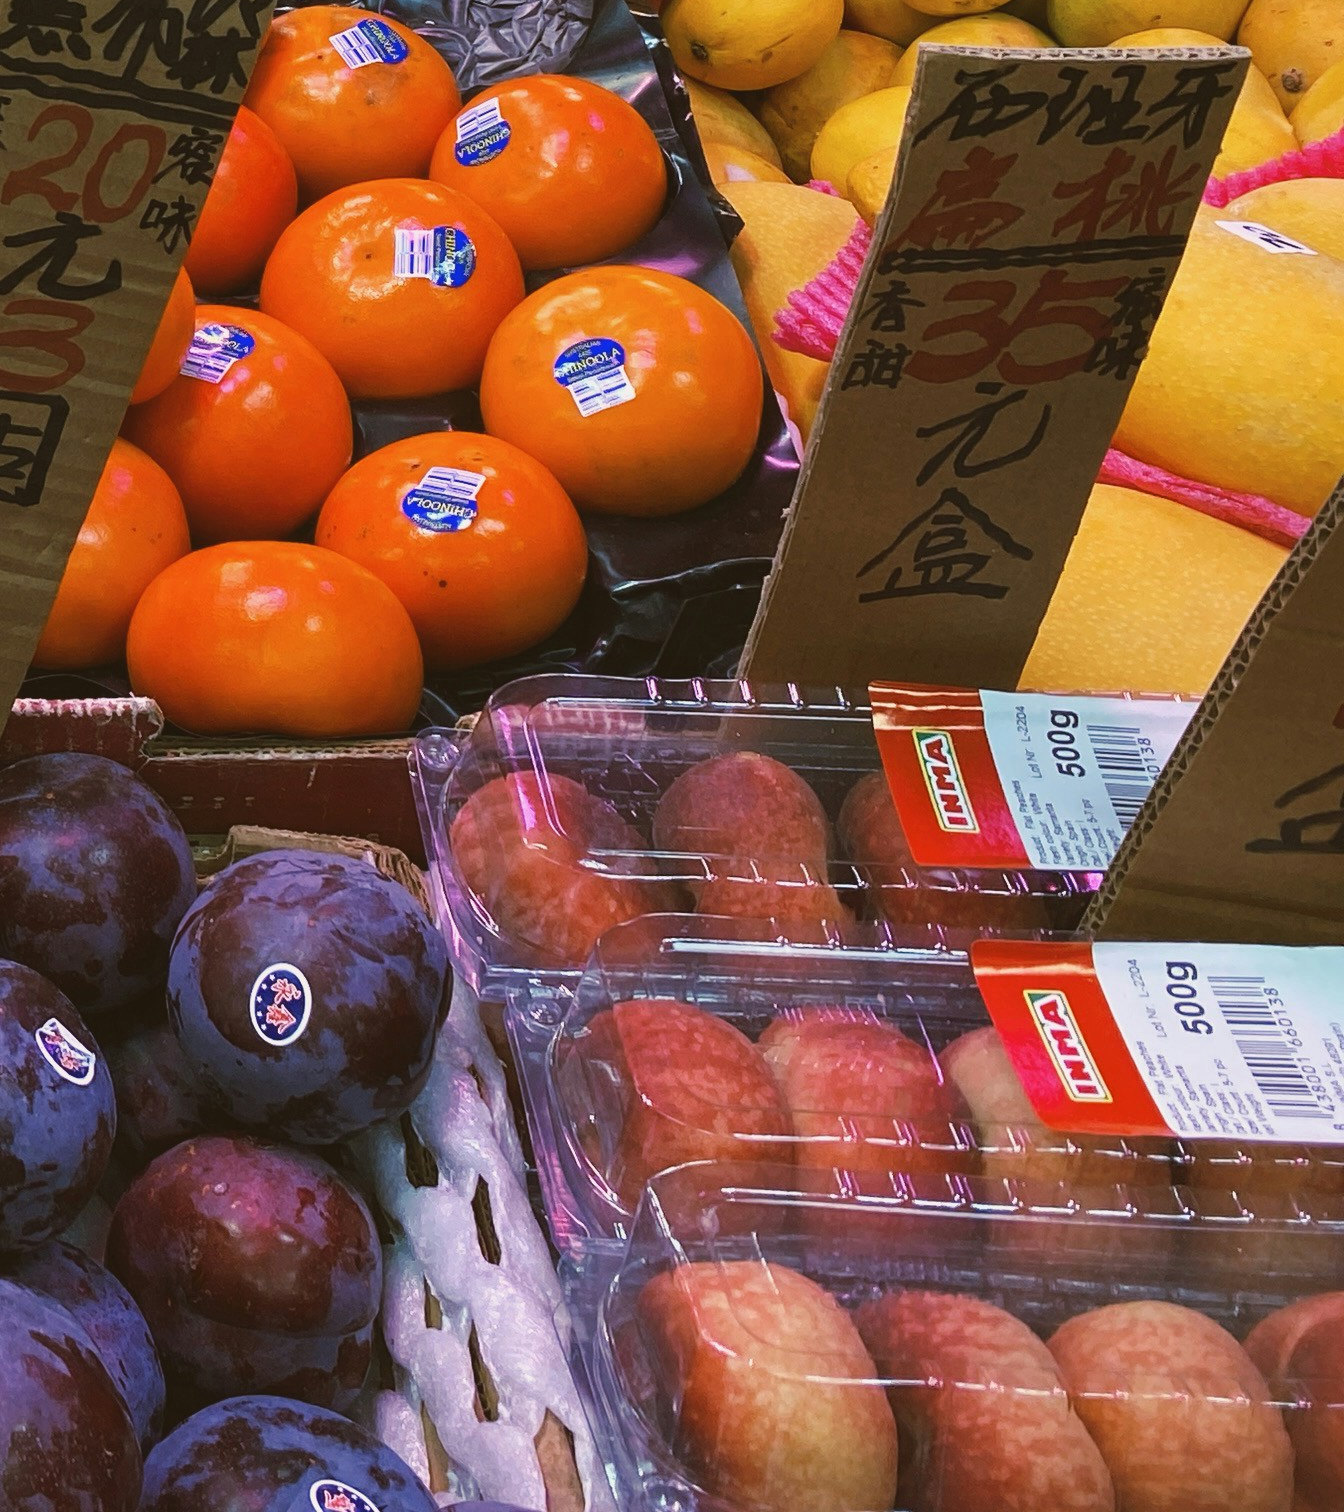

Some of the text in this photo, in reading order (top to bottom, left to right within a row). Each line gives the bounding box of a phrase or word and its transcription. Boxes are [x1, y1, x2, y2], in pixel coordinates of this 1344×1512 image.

[912, 63, 1241, 150] 西班牙
[0, 103, 168, 224] 20
[903, 268, 1132, 385] 35
[915, 380, 1054, 488] 元
[854, 488, 1034, 604] 盒
[925, 737, 969, 827] INMA
[1045, 709, 1087, 779] 500g
[1164, 960, 1214, 1037] 500g
[1262, 986, 1305, 1049] 660138
[1039, 997, 1100, 1096] INMA
